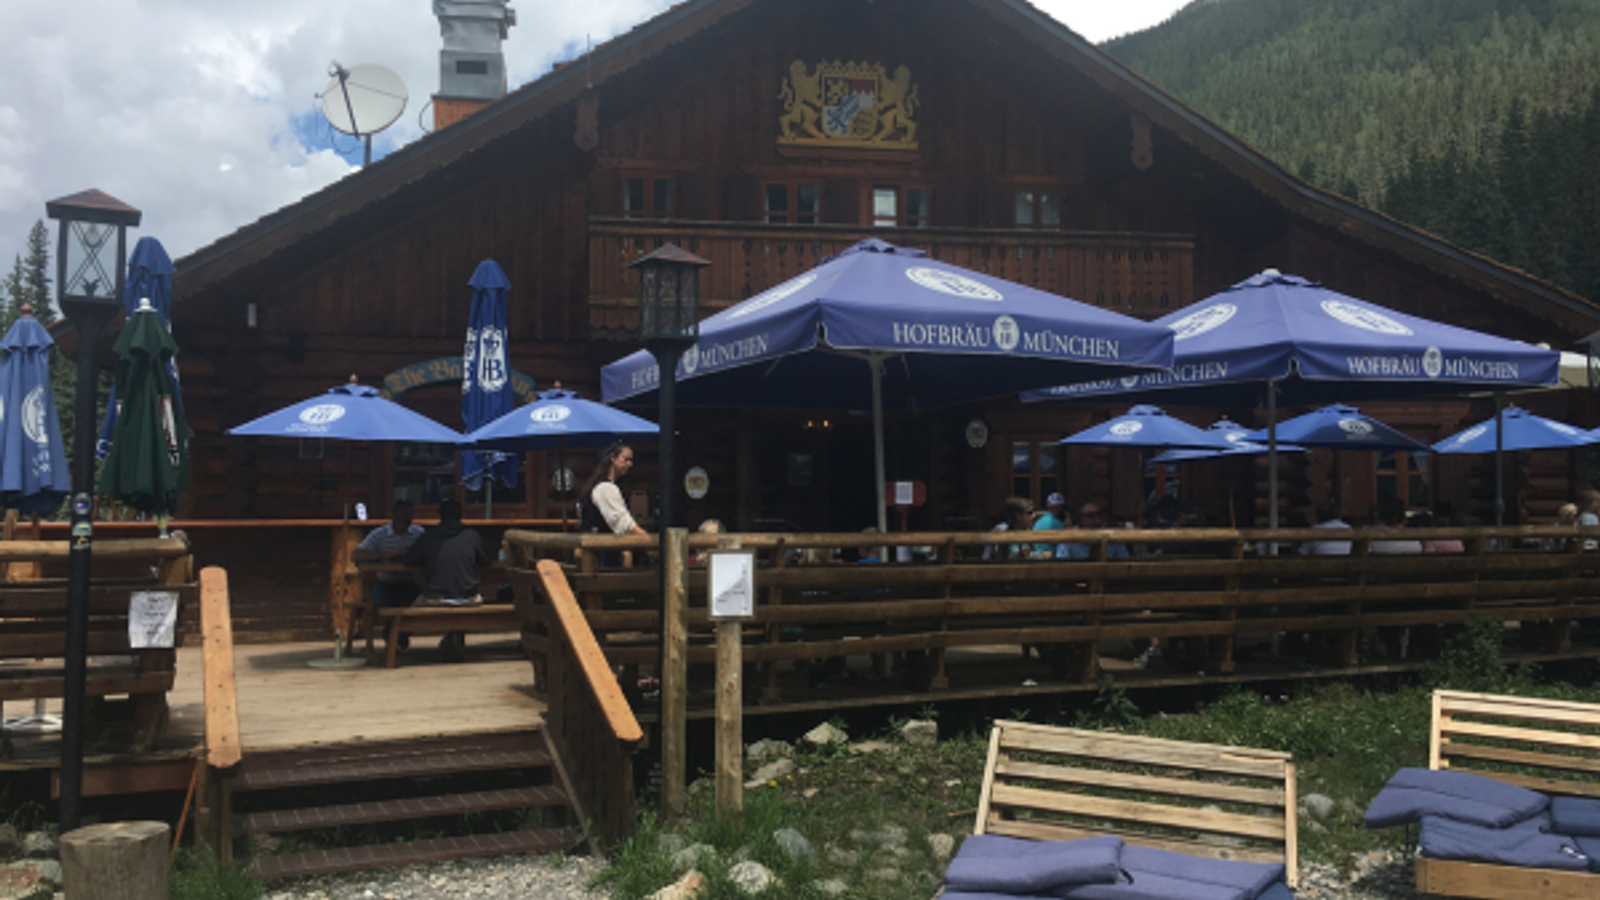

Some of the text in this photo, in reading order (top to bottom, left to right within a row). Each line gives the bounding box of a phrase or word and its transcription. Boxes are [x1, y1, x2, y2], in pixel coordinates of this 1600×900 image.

[701, 333, 768, 368] MÜNCHEN
[892, 322, 990, 347] HOFBRÄU
[1023, 330, 1119, 359] MÜNCHEN
[1347, 354, 1420, 376] HOFBRÄU
[1445, 357, 1518, 379] MÜNCHEN
